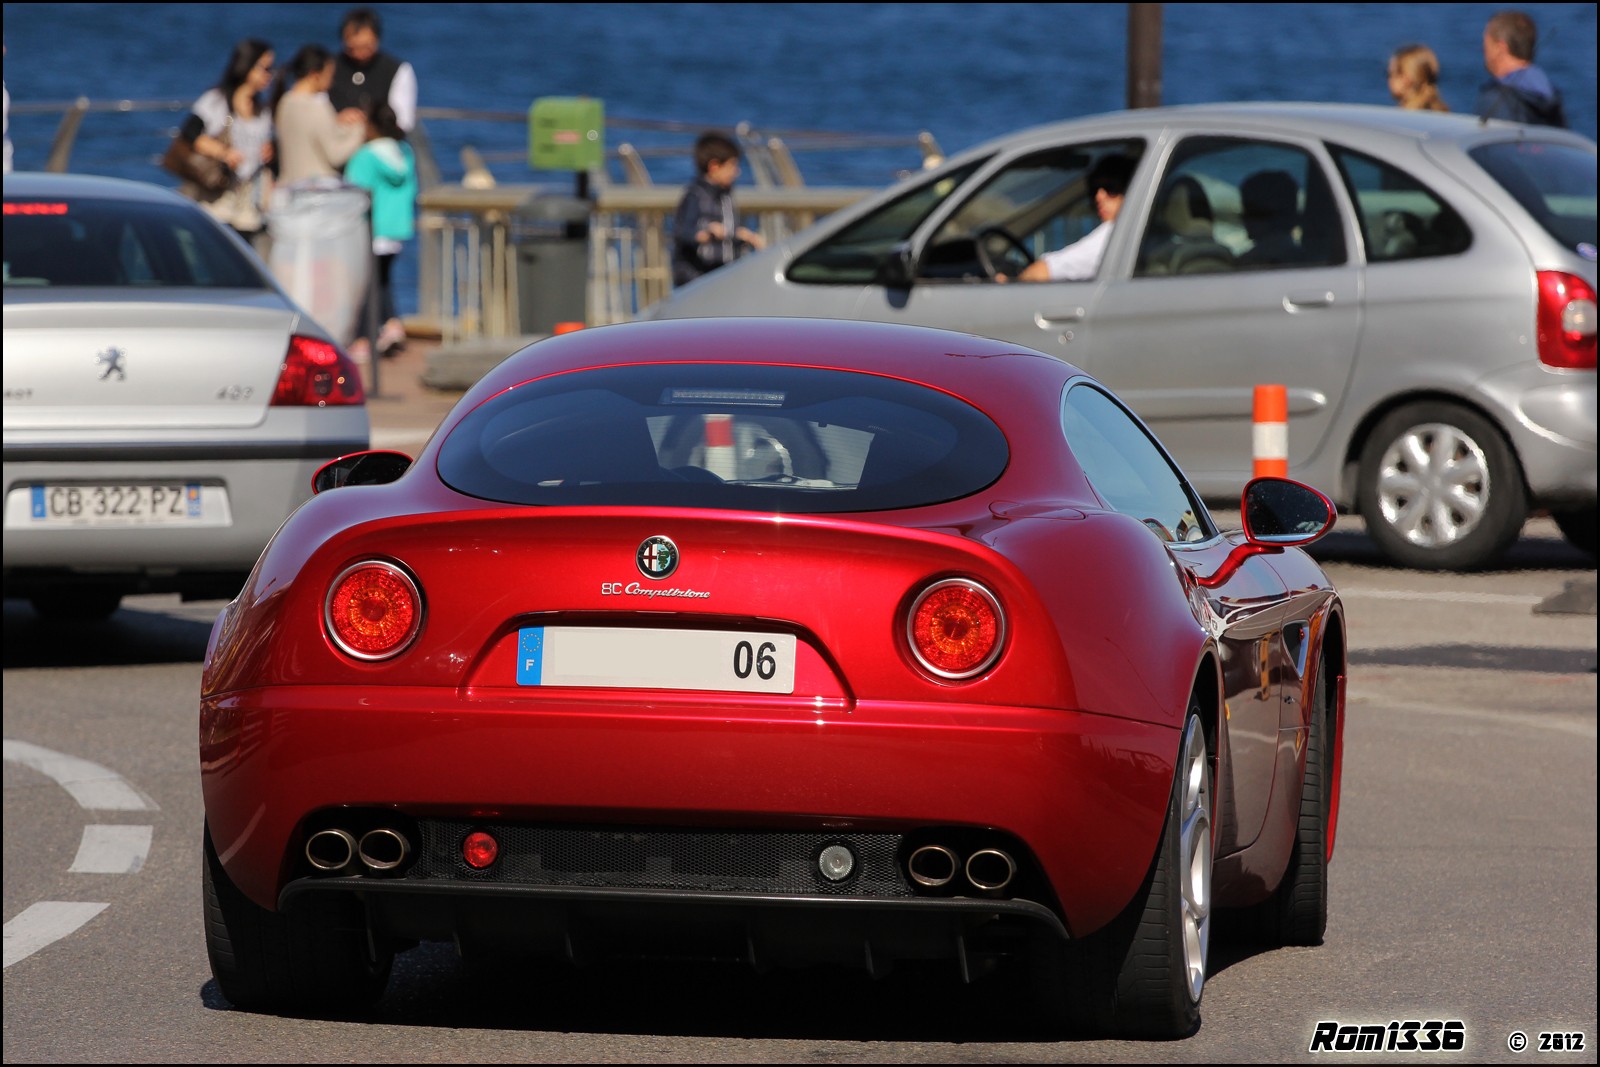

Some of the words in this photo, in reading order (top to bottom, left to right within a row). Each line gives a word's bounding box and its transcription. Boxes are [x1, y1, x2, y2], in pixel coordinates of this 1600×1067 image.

[601, 582, 622, 595] 8C
[624, 582, 711, 599] Competizione
[525, 659, 535, 671] F
[733, 640, 777, 680] 06
